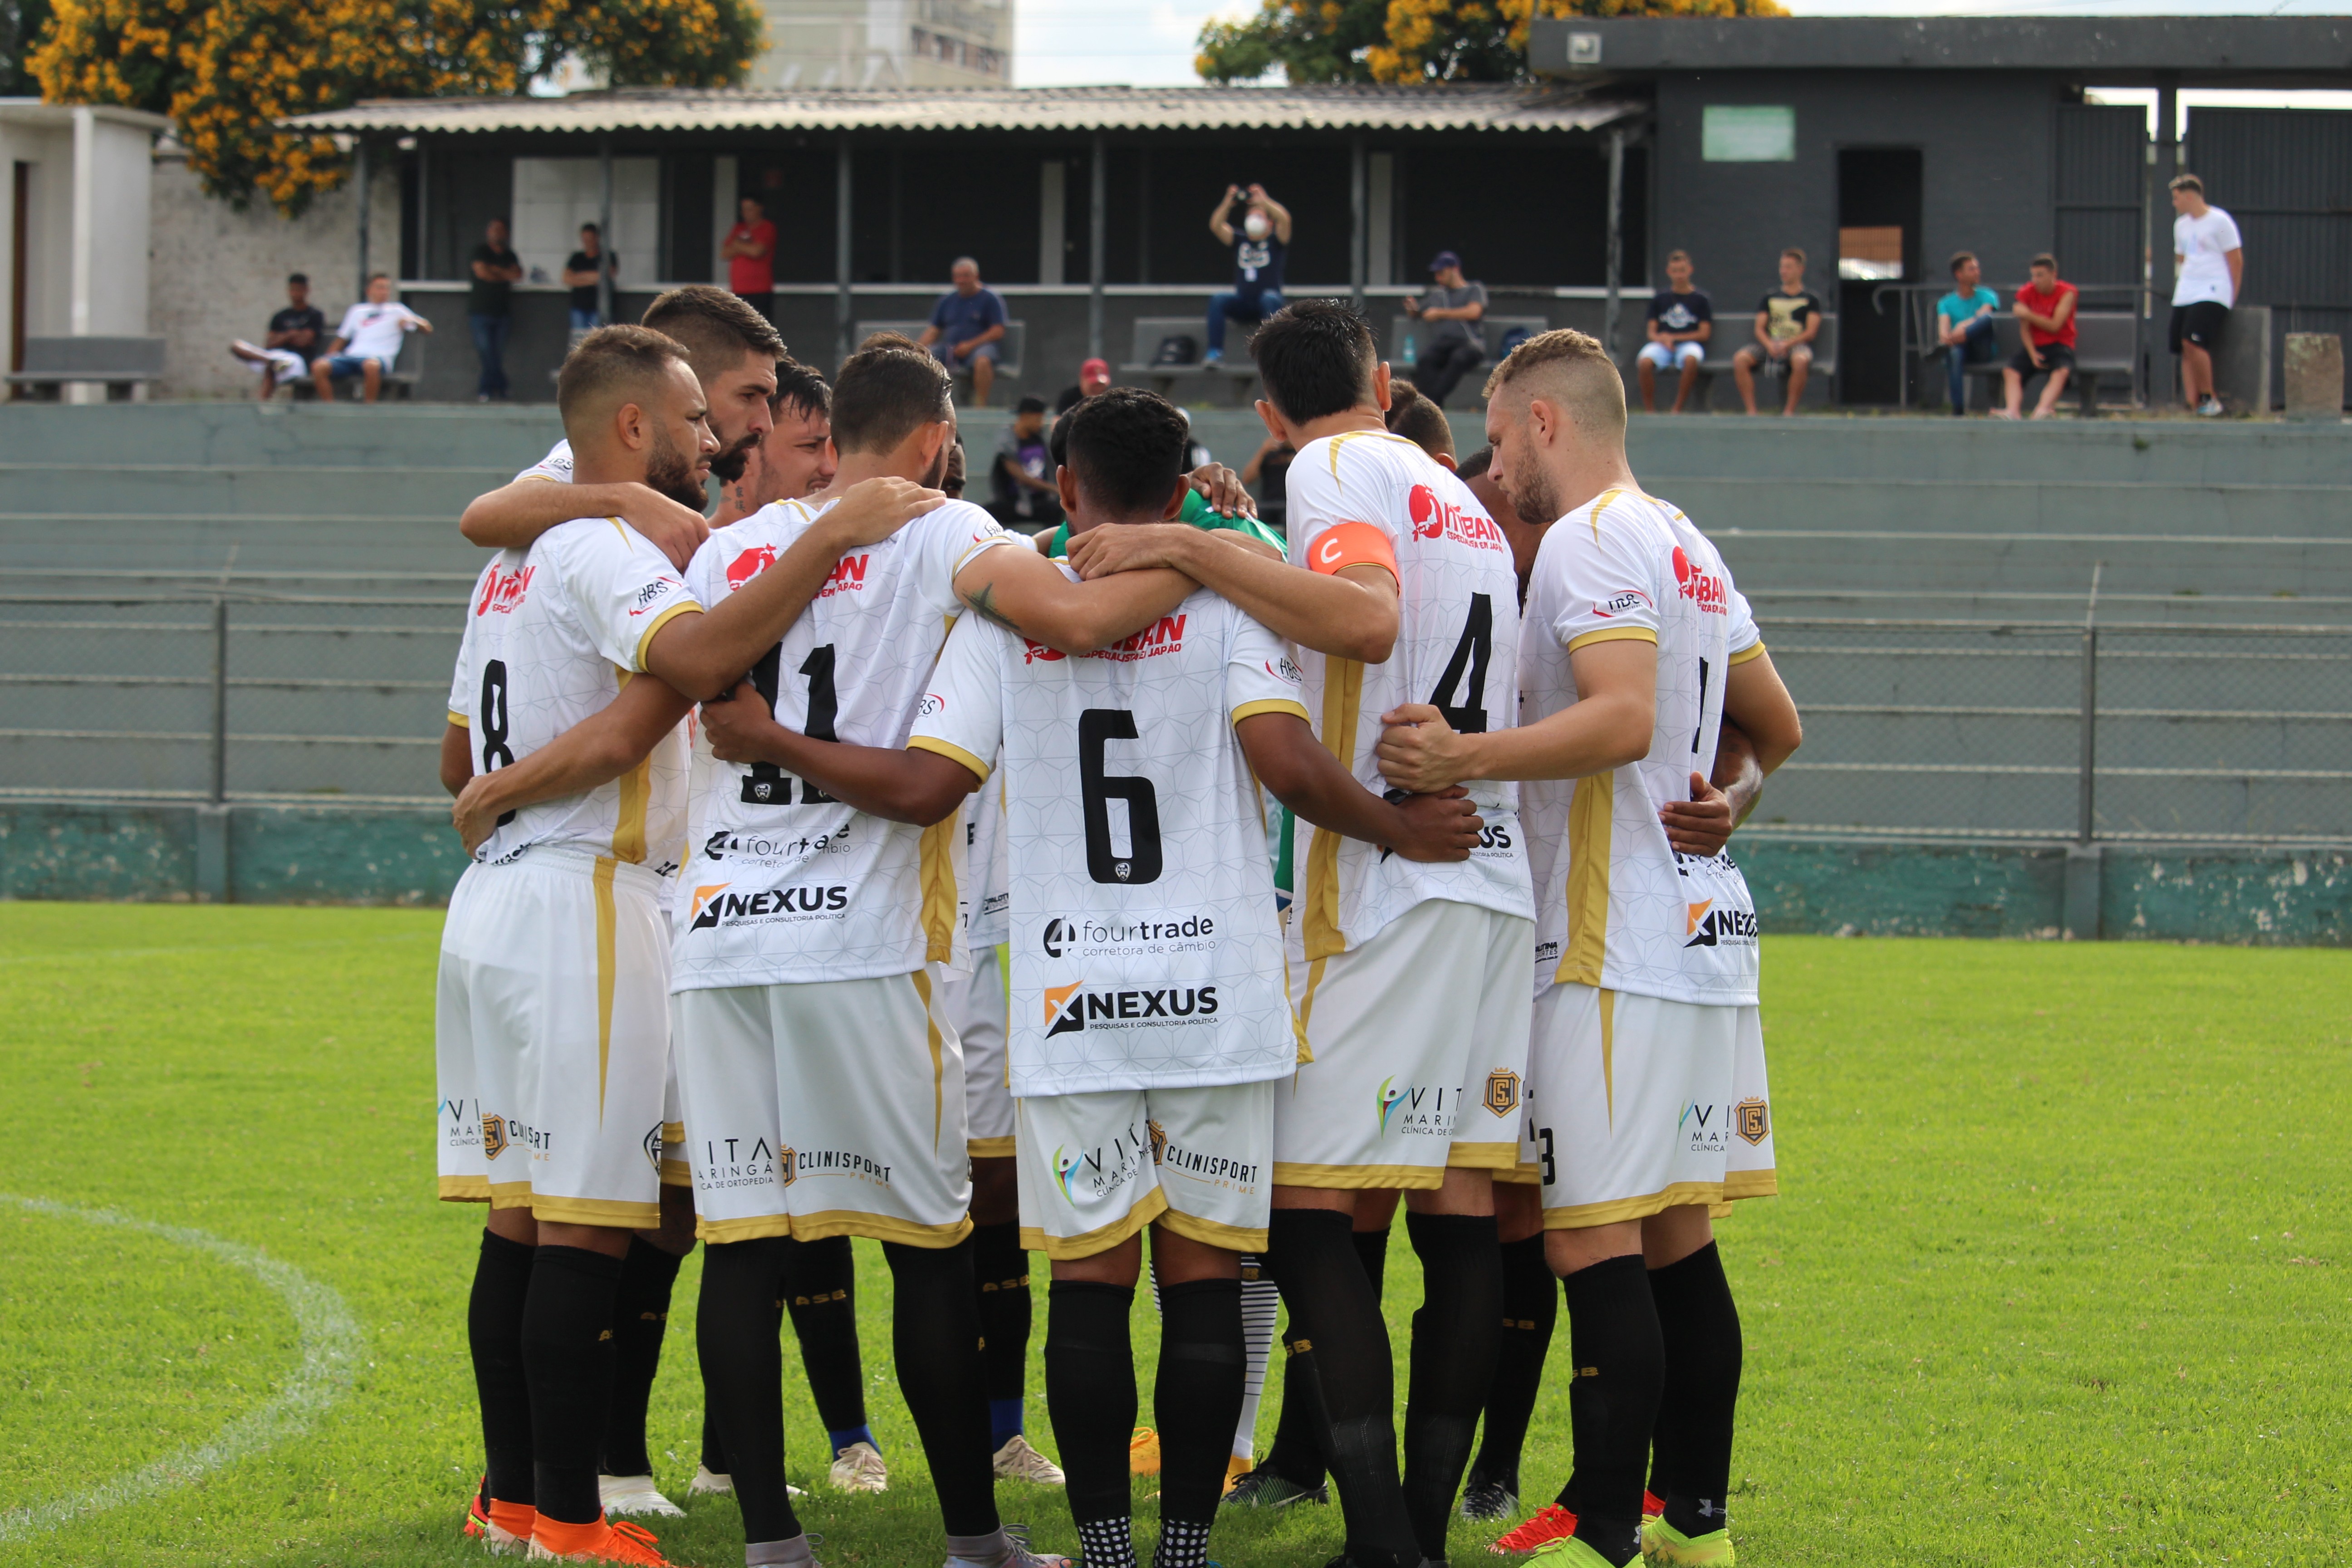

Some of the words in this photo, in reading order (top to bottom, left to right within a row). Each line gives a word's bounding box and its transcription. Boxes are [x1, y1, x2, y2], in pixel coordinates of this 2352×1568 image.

[1321, 538, 1342, 564] C
[638, 582, 668, 605] HBS
[1428, 592, 1492, 734] 4
[481, 659, 516, 828] 8
[1078, 709, 1163, 884] 6
[724, 886, 848, 917] NEXUS
[765, 915, 813, 924] CONSULTORIA
[1083, 916, 1214, 943] fourtrade
[1083, 946, 1143, 957] corretora
[1148, 944, 1165, 954] de
[1169, 940, 1216, 952] câmbio
[1088, 986, 1218, 1020] NEXUS
[1137, 1019, 1187, 1028] CONSULTORIA
[1411, 1087, 1462, 1112] VIT
[1401, 1125, 1434, 1136] CLÍNICA
[708, 1136, 773, 1165] ITA
[1691, 1142, 1725, 1152] CLÍNICA
[799, 1151, 891, 1182] CLINISPORT
[1167, 1145, 1257, 1183] CLINISPORT
[715, 1180, 725, 1189] DE
[727, 1176, 774, 1188] ORTOPEDIA
[849, 1171, 891, 1191] PRIME
[1214, 1179, 1255, 1195] PRIME
